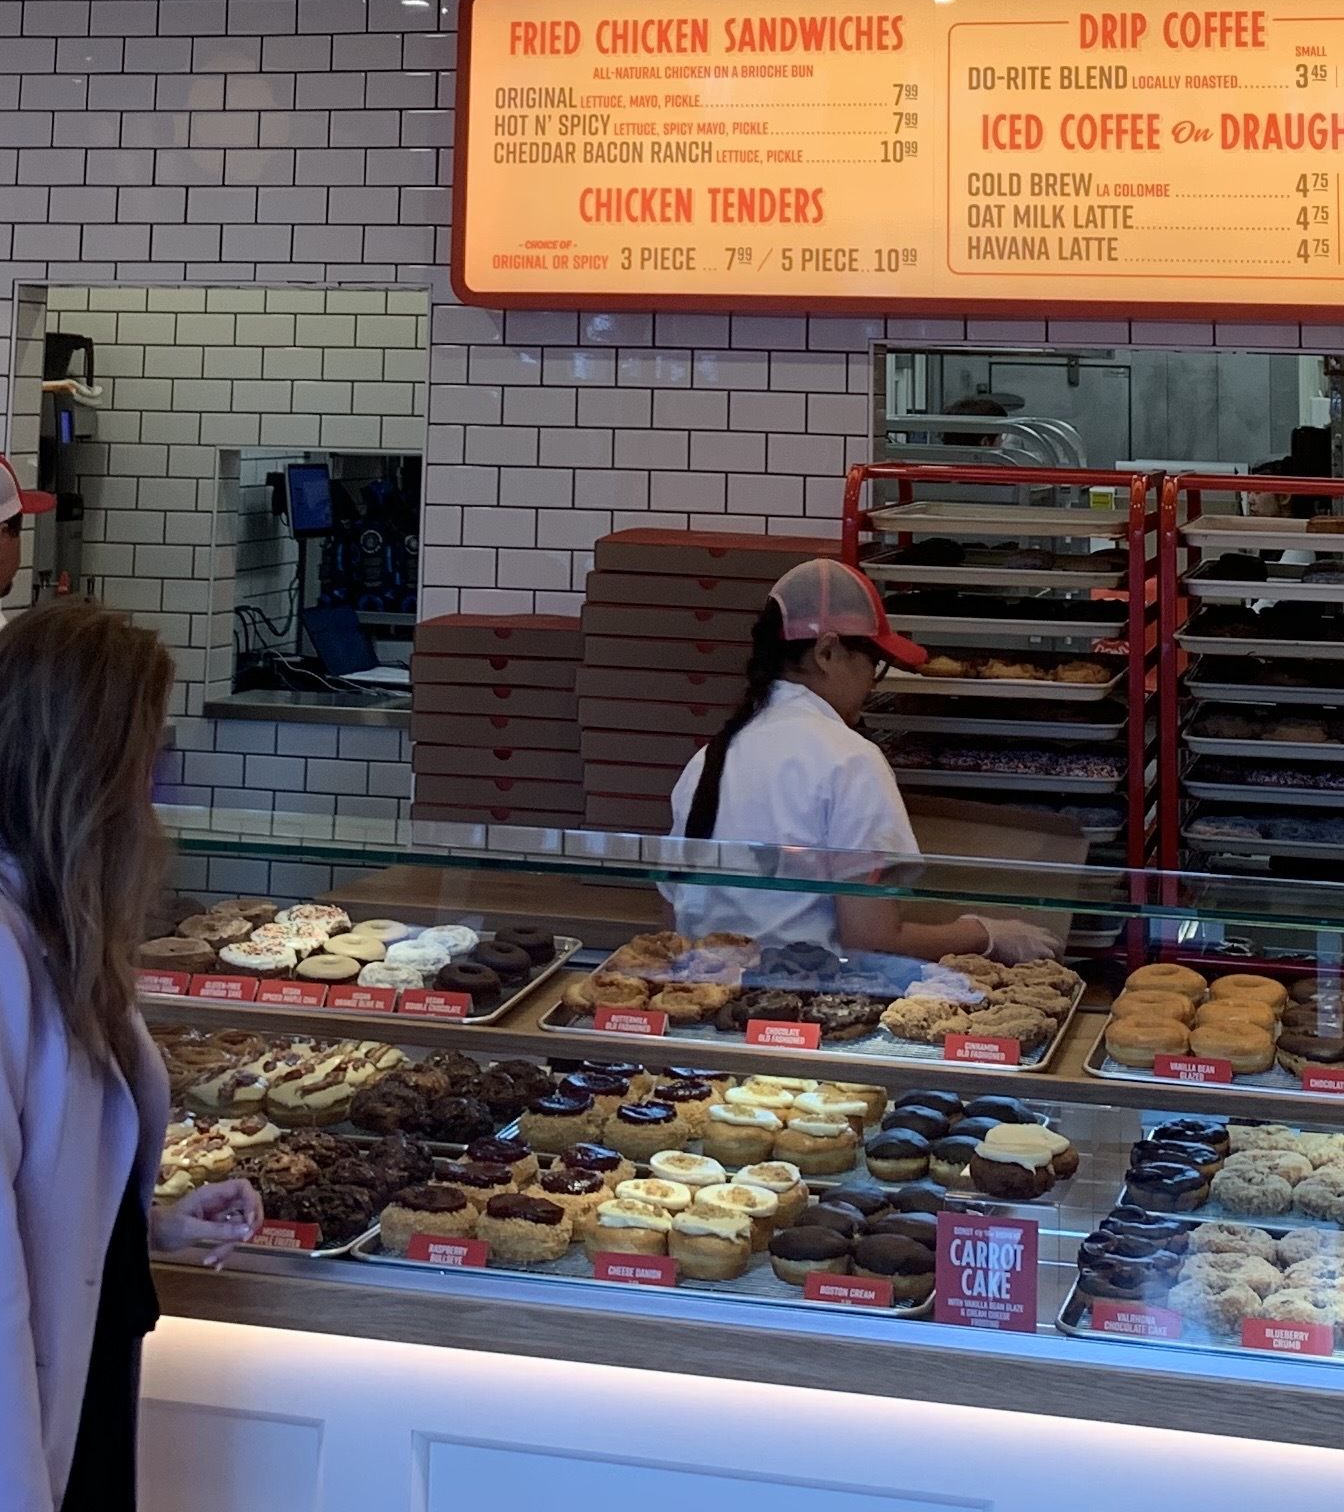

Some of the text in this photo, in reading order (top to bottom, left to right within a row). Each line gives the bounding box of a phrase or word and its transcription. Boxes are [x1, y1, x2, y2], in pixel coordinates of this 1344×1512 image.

[510, 15, 904, 56] FRIED CHICKEN SANDWICHES
[1080, 11, 1265, 49] DRIP COFFEE
[1295, 46, 1327, 57] SMALL
[593, 65, 814, 80] ALL-NATURAL CHICKEN ON A BRIOCHE BUN
[968, 66, 1051, 90] DO-RITE
[1059, 66, 1128, 89] BLEND
[1132, 75, 1181, 89] LOCALLY
[1185, 75, 1238, 89] ROASTED
[494, 88, 577, 109] ORIGINAL
[580, 95, 626, 109] LETTUCE,
[629, 95, 659, 109] MAYO,
[665, 95, 699, 108] PICKLE
[494, 116, 528, 136] HOT
[558, 115, 611, 136] SPICY
[614, 123, 659, 137] LETTUCE,
[663, 122, 693, 136] SPICY
[697, 122, 728, 136] MAYO,
[732, 122, 769, 135] PICKLE
[981, 114, 1043, 150] ICED
[1060, 114, 1160, 150] COFFEE
[1171, 121, 1213, 144] On
[494, 143, 576, 164] CHEDDAR
[583, 143, 644, 164] BACON
[650, 142, 712, 163] RANCH
[716, 150, 763, 164] LETTUCE,
[766, 149, 803, 163] PICKLE
[967, 173, 1024, 197] COLD
[1030, 173, 1092, 197] BREW
[1097, 183, 1111, 197] LA
[1114, 183, 1170, 198] COLOMBE
[580, 187, 824, 224] CHICKEN TENDERS
[967, 205, 1007, 228] OAT
[1013, 205, 1065, 228] MILK
[1073, 205, 1134, 229] LATTE
[492, 255, 549, 269] ORIGINAL
[552, 255, 569, 269] OR
[572, 255, 608, 270] SPICY
[620, 248, 632, 270] 3
[640, 248, 695, 271] PIECE
[781, 248, 793, 271] 5
[802, 249, 858, 272] PIECE
[968, 237, 1050, 260] HAVANA
[1058, 238, 1118, 261] LATTE
[1170, 1062, 1215, 1074] VANILLA BEAN
[950, 1239, 1024, 1271] CARROT
[961, 1269, 1010, 1300] CAKE
[1265, 1328, 1309, 1341] BLUEBERRY
[1273, 1338, 1301, 1350] CRUMB
